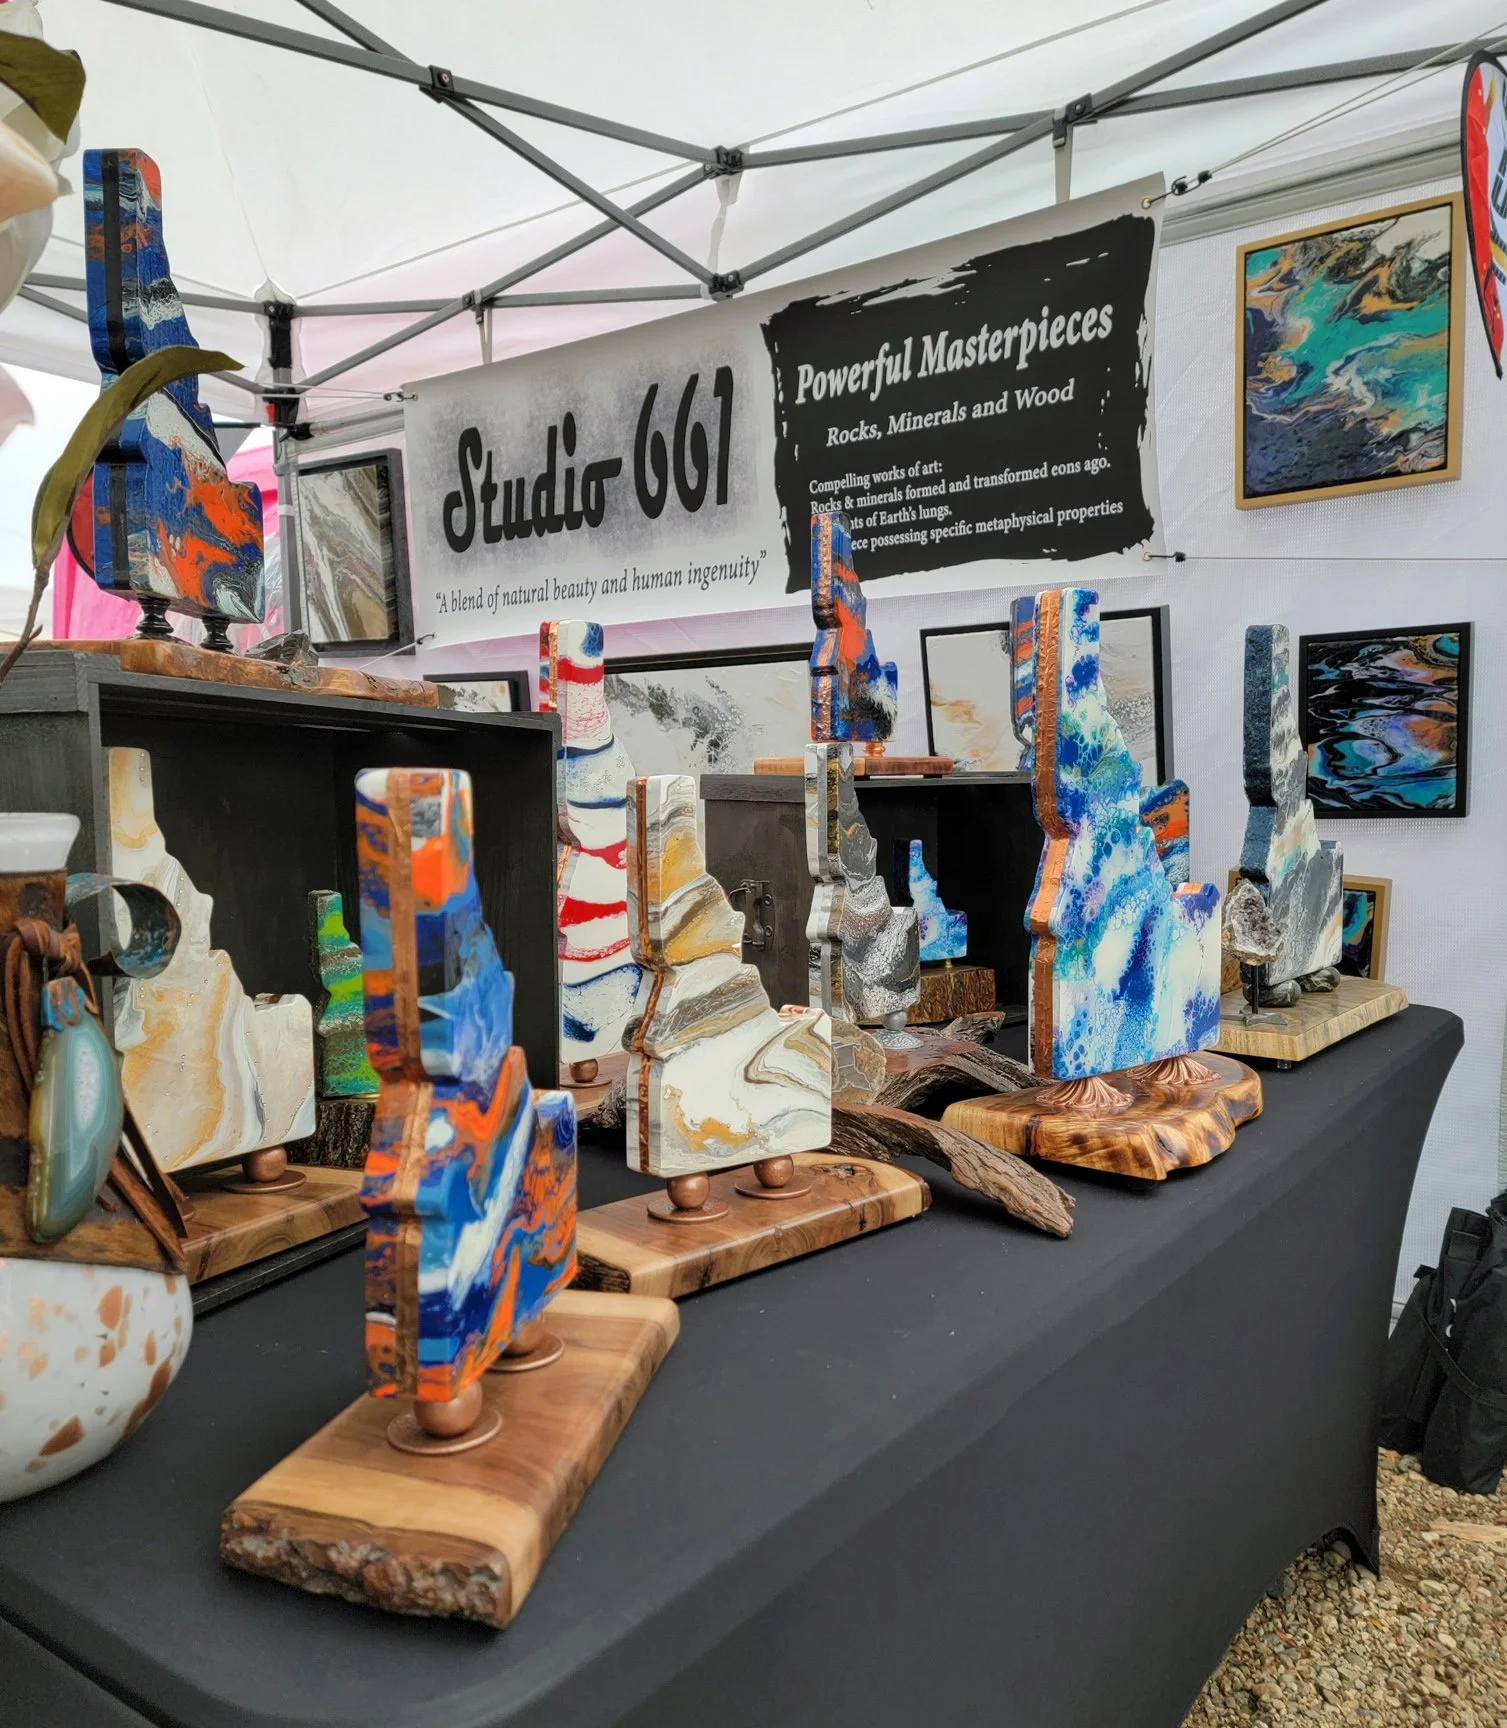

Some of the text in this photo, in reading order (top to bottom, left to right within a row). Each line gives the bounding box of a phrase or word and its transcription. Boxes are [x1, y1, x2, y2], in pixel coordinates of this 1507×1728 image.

[795, 303, 1114, 404] Powerful Masterpieces
[826, 378, 1075, 447] Rocks, Minerals and Wood
[442, 365, 734, 553] Studio 661
[809, 460, 943, 494] Compelling works of art:
[810, 456, 1111, 514] Rocks & minerals formed and transformed eons ago.
[851, 499, 1124, 552] ece possessing specific metaphysical properties
[866, 511, 877, 527] of
[918, 504, 952, 522] lungs.
[451, 587, 484, 612] blend
[487, 584, 501, 615] of
[502, 578, 549, 606] natural
[553, 577, 598, 604] beauty
[601, 568, 628, 595] and
[632, 567, 682, 591] human
